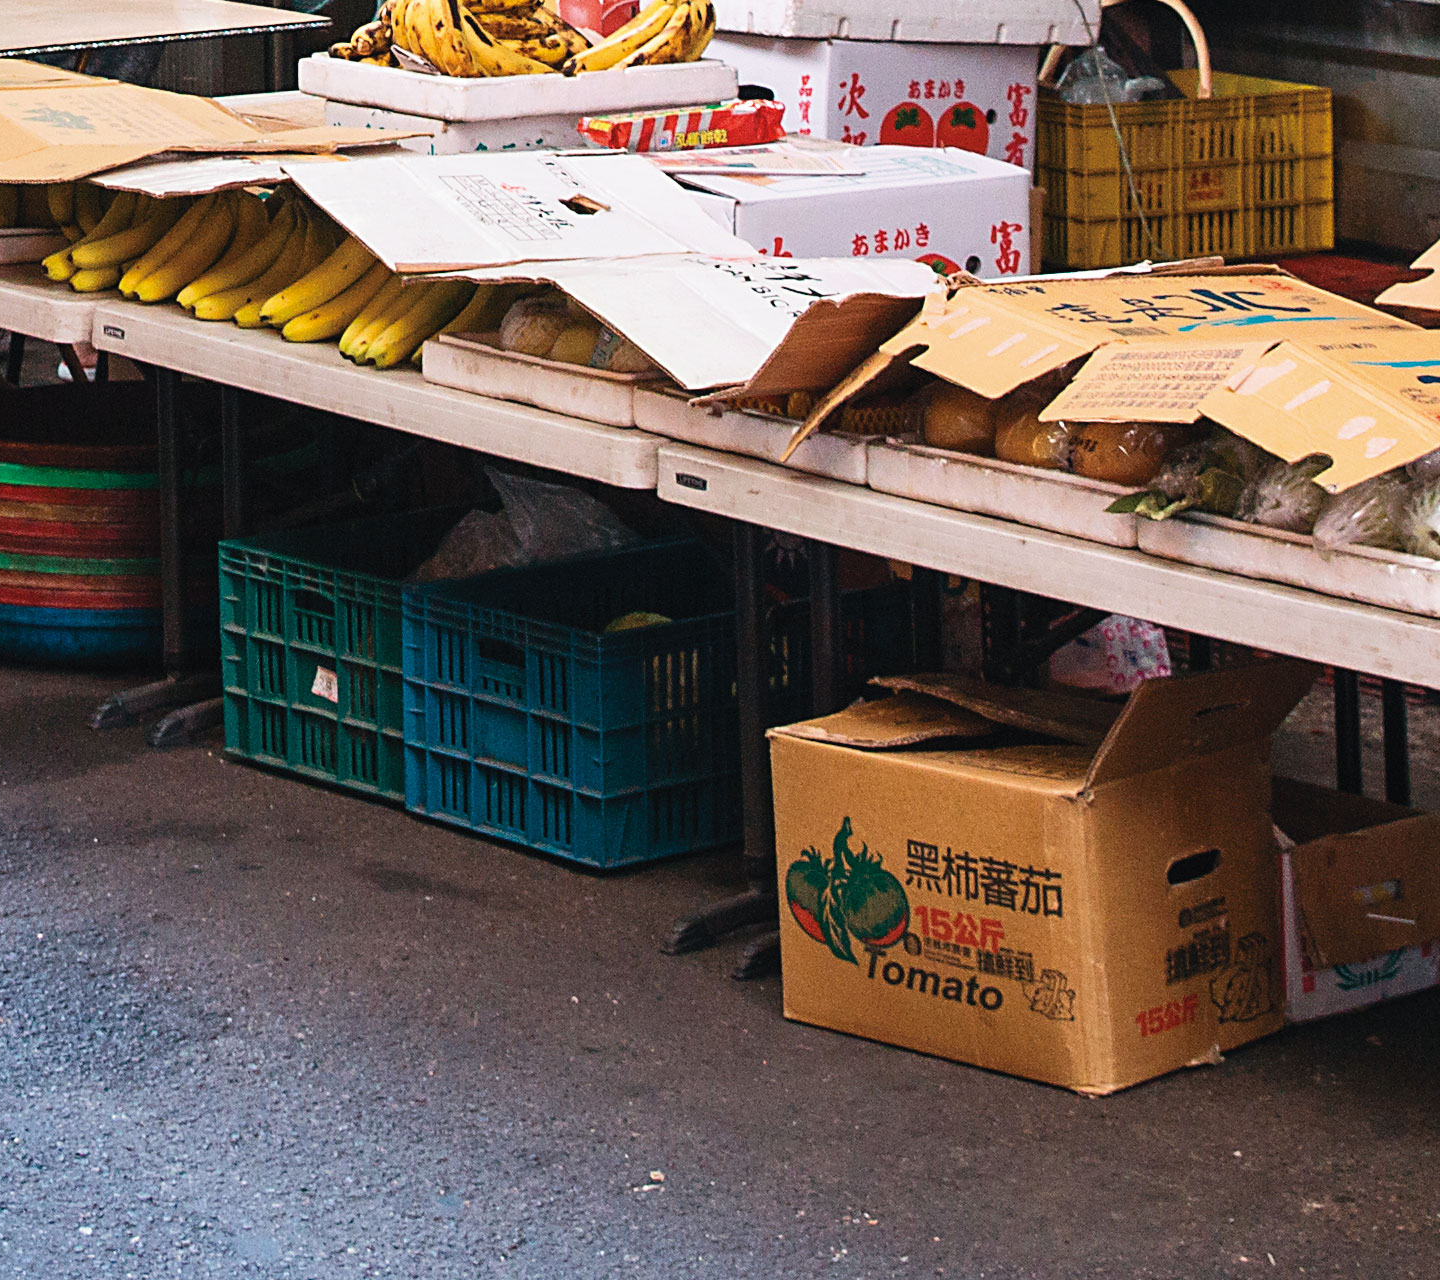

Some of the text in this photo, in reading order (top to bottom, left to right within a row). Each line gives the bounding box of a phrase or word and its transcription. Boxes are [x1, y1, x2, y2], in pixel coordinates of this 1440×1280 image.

[908, 79, 966, 99] あまかき
[852, 222, 930, 256] あまかき
[905, 838, 1063, 917] 黑柿蕃茄
[914, 905, 1005, 953] 15公斤
[862, 946, 1005, 1011] Tomato
[1135, 993, 1200, 1038] 15公斤
